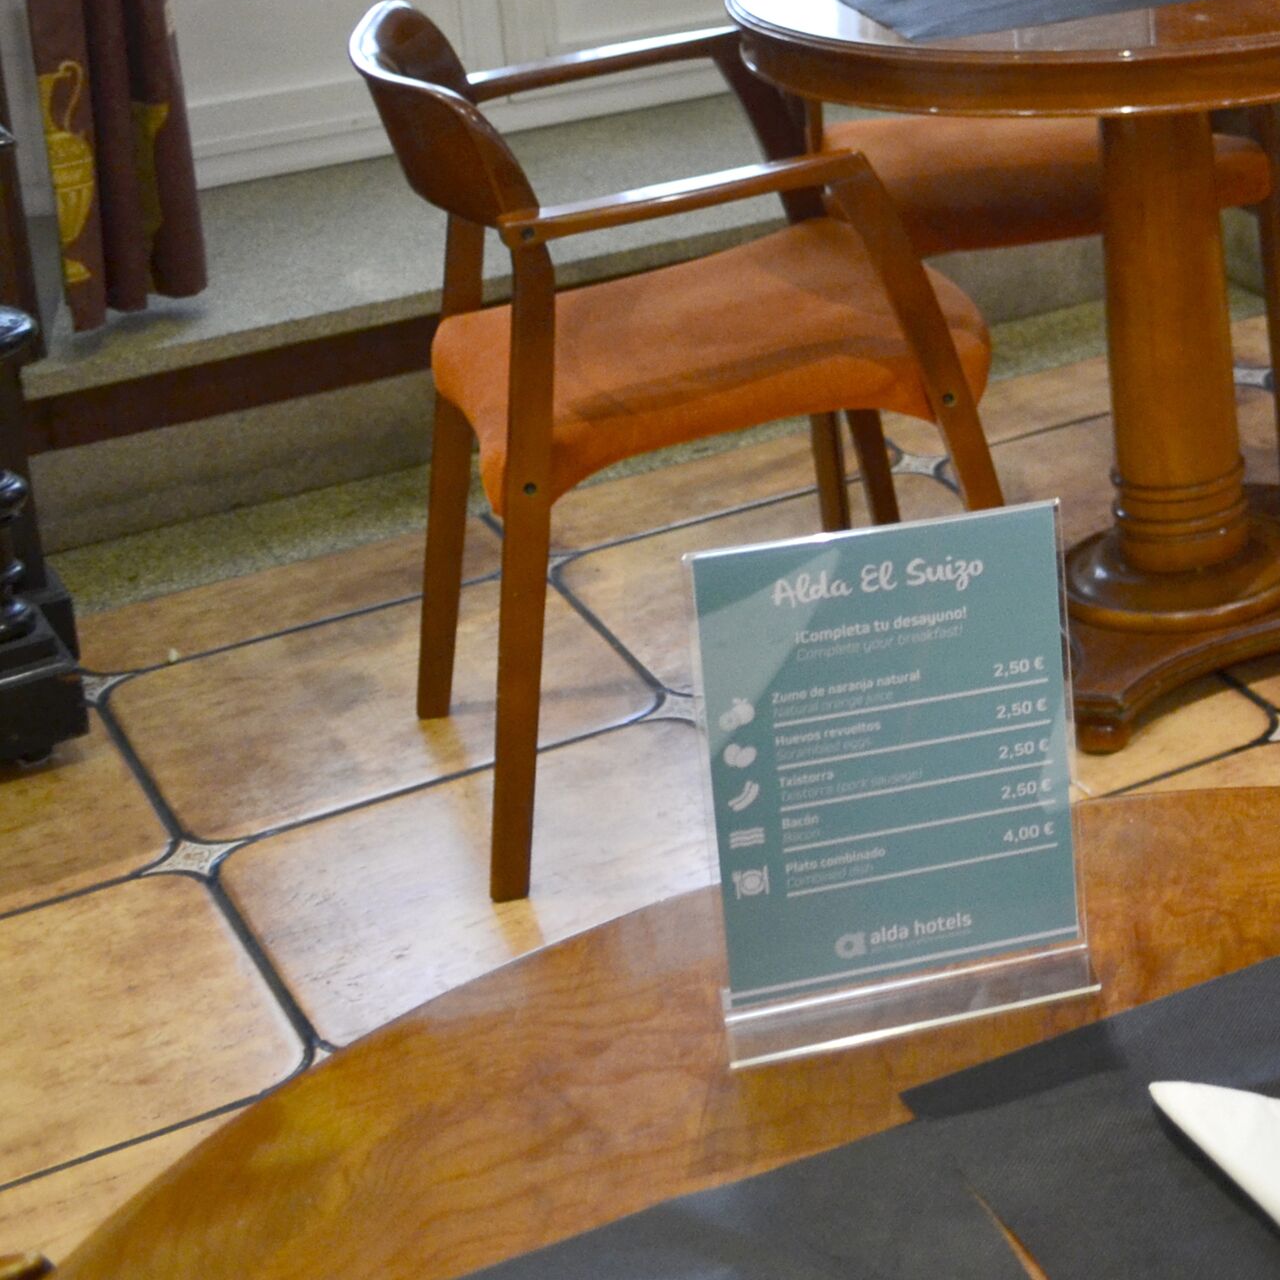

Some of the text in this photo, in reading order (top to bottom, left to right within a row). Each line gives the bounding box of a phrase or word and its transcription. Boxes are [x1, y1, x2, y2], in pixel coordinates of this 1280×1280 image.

[771, 556, 984, 608] Alda El Suizo
[873, 620, 890, 632] tu
[893, 606, 967, 630] desayuno!
[863, 634, 893, 654] your
[896, 624, 963, 646] breakfast!
[994, 652, 1045, 678] 2,50 €
[772, 670, 921, 704] Zumo de naranja natural
[996, 697, 1048, 719] 2,50 €
[775, 720, 881, 746] Huevos revueltos
[999, 737, 1050, 760] 2,50 €
[1041, 777, 1053, 792] €
[1003, 821, 1055, 844] 4,00 €
[785, 846, 886, 874] Plato combinado
[870, 923, 909, 945] alda
[914, 912, 973, 936] hotels
